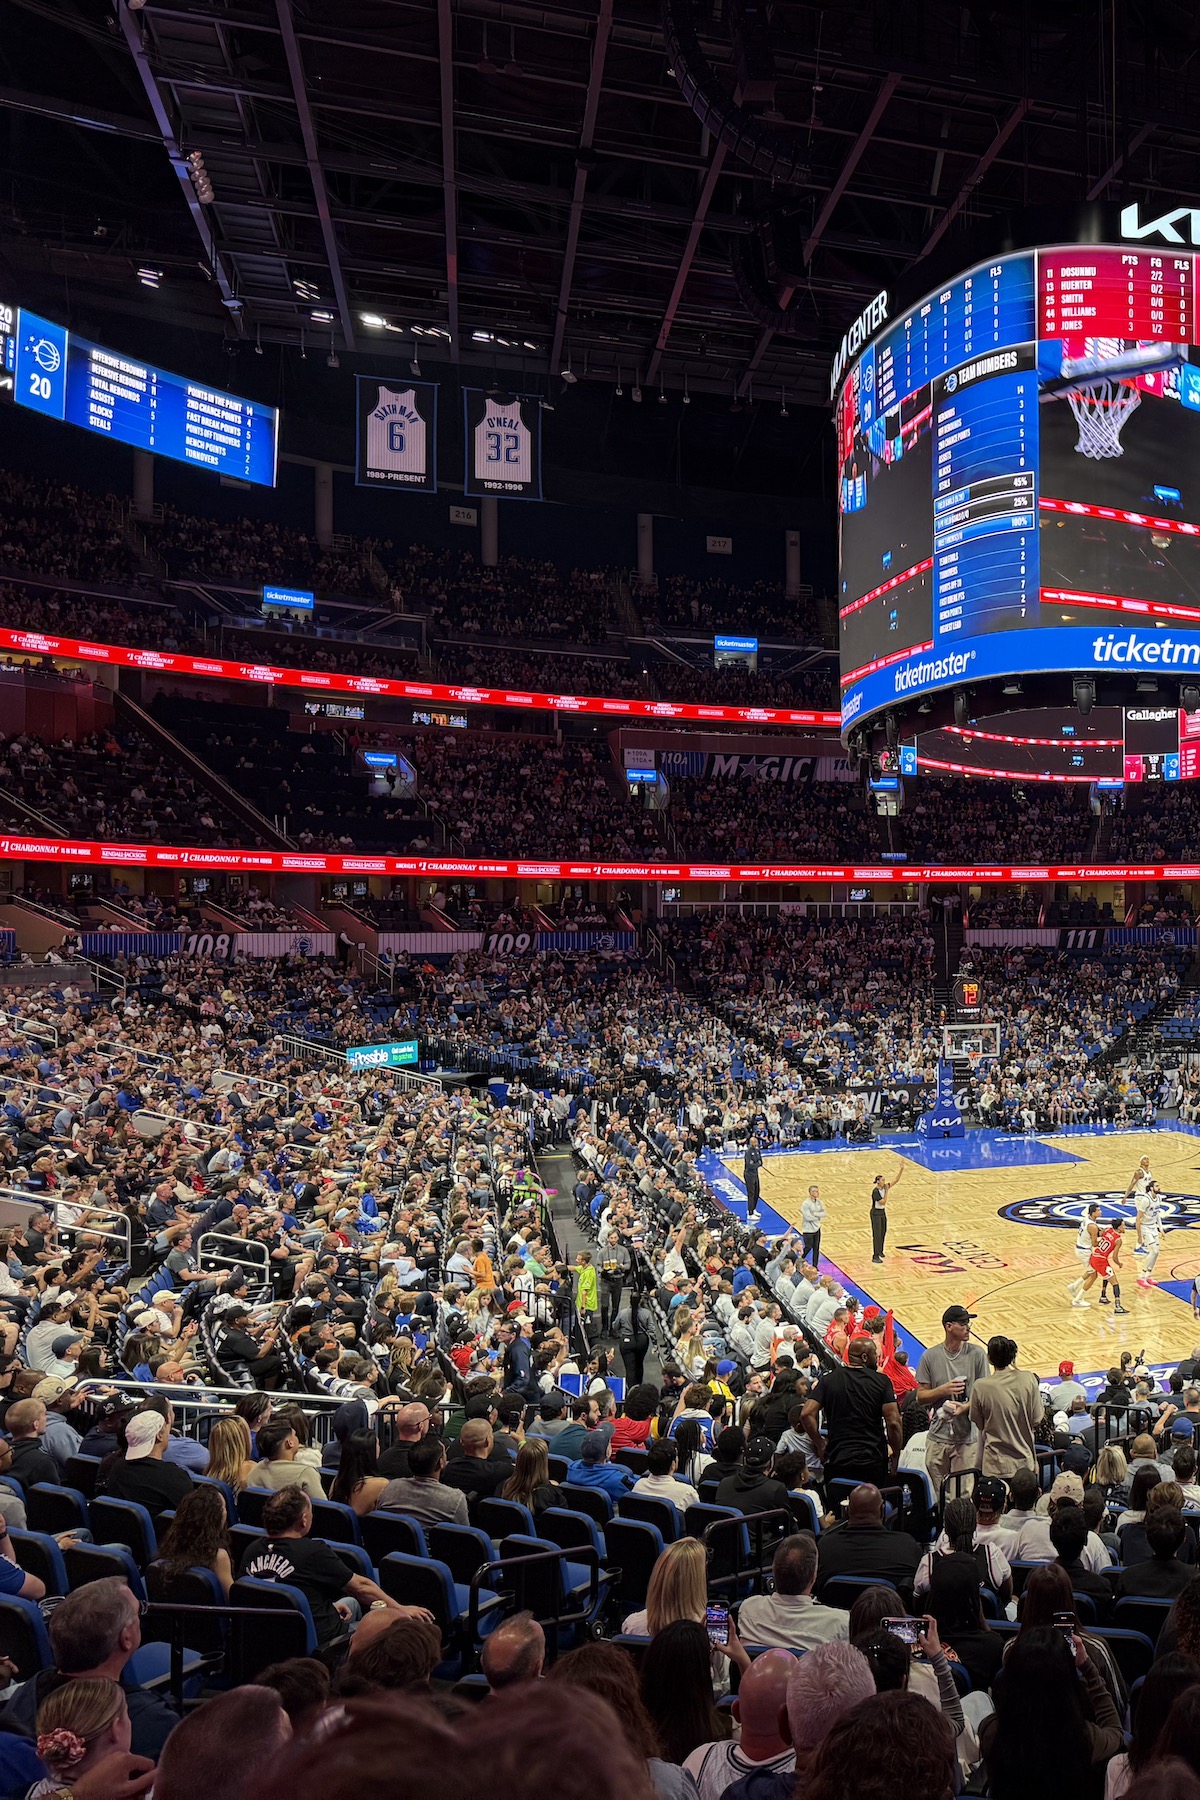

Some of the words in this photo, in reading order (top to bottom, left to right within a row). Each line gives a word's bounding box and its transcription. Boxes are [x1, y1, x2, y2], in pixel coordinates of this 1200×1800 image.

[1122, 255, 1138, 266] PTS
[1151, 258, 1162, 268] FG
[1174, 260, 1190, 270] FLS
[989, 265, 1002, 279] FLS
[1047, 269, 1053, 278] 11
[1060, 266, 1096, 277] DOSUNMU
[1151, 271, 1163, 281] 2/2
[1046, 282, 1054, 292] 13
[1061, 280, 1092, 291] HUERTER
[1151, 284, 1163, 294] 0/2
[1045, 295, 1055, 305] 25
[1061, 294, 1084, 304] SMITH
[1151, 298, 1163, 307] 0/0
[1046, 308, 1055, 318] 44
[1061, 307, 1096, 317] WILLIAMS
[1128, 308, 1134, 318] 0
[1151, 310, 1163, 320] 0/0
[848, 290, 888, 357] CENTER
[1046, 322, 1055, 332] 30
[1061, 320, 1083, 331] JONES
[1152, 324, 1163, 334] 1/2
[92, 350, 120, 369] OFFENSIVE
[120, 360, 147, 379] REBOUNDS
[152, 373, 157, 383] 3
[958, 362, 977, 386] TEAM
[977, 351, 1018, 377] NUMBERS
[30, 372, 51, 399] 20
[91, 363, 119, 382] DEFENSIVE
[119, 373, 146, 392] REBOUNDS
[151, 386, 156, 396] 11
[91, 376, 110, 392] TOTAL
[110, 384, 141, 403] REBOUNDS
[150, 399, 157, 409] 14
[1017, 385, 1024, 395] 14
[90, 389, 115, 406] ASSISTS
[151, 411, 155, 421] 5
[187, 386, 207, 402] POINTS
[226, 397, 242, 412] PAINT
[1019, 399, 1024, 409] 3
[90, 403, 113, 419] BLOCKS
[187, 399, 199, 411] 2ND
[199, 402, 221, 418] CHANCE
[221, 409, 242, 424] POINTS
[374, 404, 397, 421] SIXTH
[398, 405, 419, 425] MAN
[863, 400, 872, 423] 20
[1019, 414, 1024, 423] 4
[89, 416, 111, 431] STEALS
[186, 411, 201, 424] FAST
[201, 415, 220, 430] BREAK
[220, 421, 241, 436] POINTS
[487, 416, 519, 431] O'NEAL
[186, 423, 204, 436] POINTS
[204, 429, 213, 439] OFF
[213, 431, 241, 448] TURNOVERS
[387, 420, 406, 453] 6
[1020, 428, 1024, 438] 5
[185, 436, 205, 449] BENCH
[205, 441, 226, 456] POINTS
[486, 431, 520, 464] 32
[185, 448, 219, 465] TURNOVERS
[366, 471, 427, 483] 1989-PRESENT
[1013, 477, 1028, 488] 45%
[483, 481, 524, 492] 1992-1996
[1014, 496, 1028, 507] 25%
[455, 510, 472, 520] 216
[1011, 517, 1028, 528] 100%
[711, 540, 727, 548] 217
[266, 592, 311, 604] ticketmaster
[717, 639, 755, 649] ticketmaster
[1127, 709, 1177, 722] Gallagher
[660, 751, 688, 766] 110A
[1130, 771, 1137, 780] 17
[1169, 769, 1176, 778] 20
[10, 843, 59, 853] CHARDONNAY
[189, 854, 241, 863] CHARDONNAY
[427, 863, 477, 871] CHARDONNAY
[187, 934, 229, 959] 108
[487, 934, 530, 955] 109
[1067, 929, 1097, 949] 111
[963, 983, 978, 992] 3:20
[965, 992, 976, 1004] 12
[355, 1049, 388, 1066] Possible
